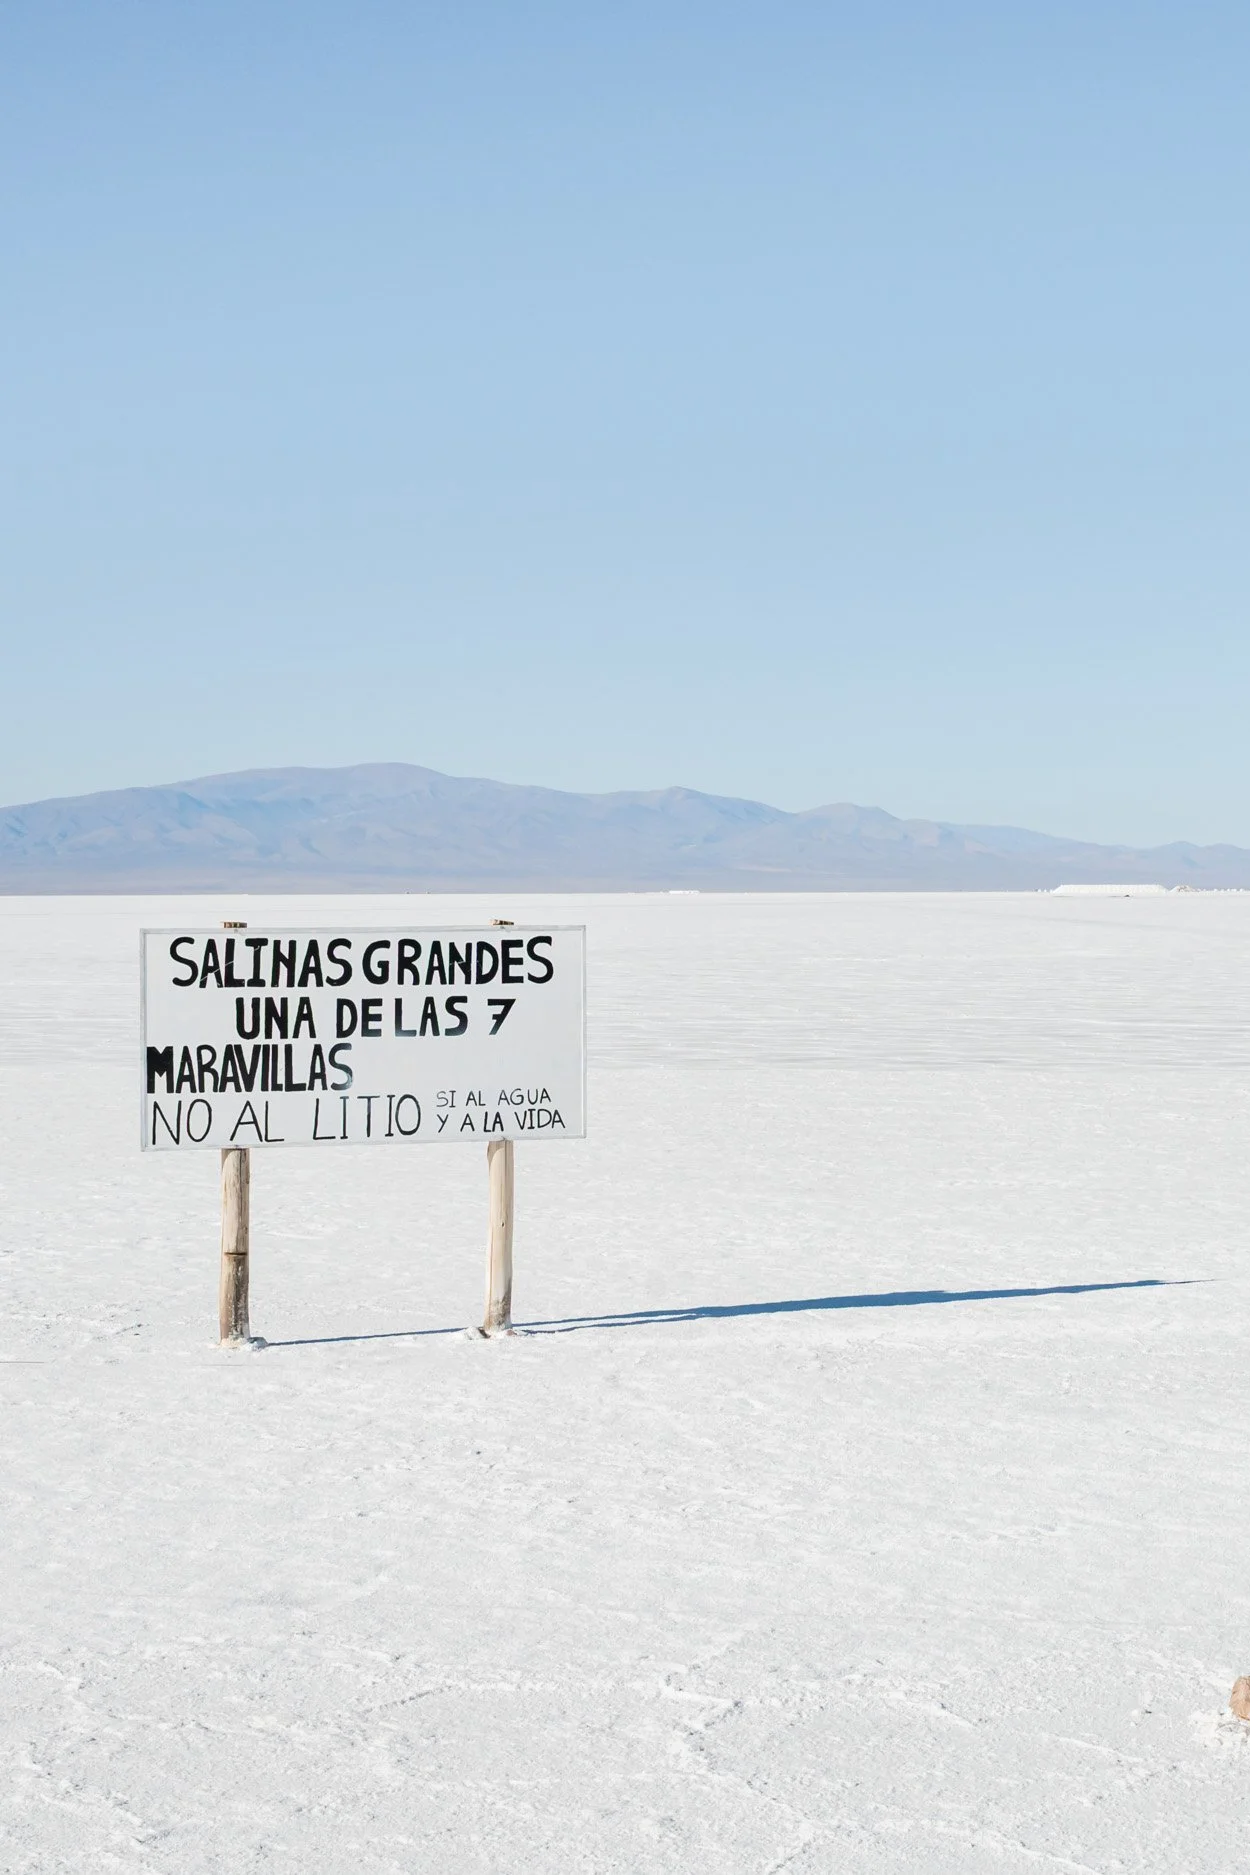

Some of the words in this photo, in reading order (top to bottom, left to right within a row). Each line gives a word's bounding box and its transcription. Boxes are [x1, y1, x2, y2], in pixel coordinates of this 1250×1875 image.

[169, 936, 353, 988] SALINAS
[362, 935, 555, 986] GRANDES
[235, 996, 317, 1040] UNA
[336, 997, 383, 1039] DE
[394, 996, 468, 1037] LAS
[487, 998, 517, 1036] 7
[146, 1042, 354, 1094] MARAVILLAS
[152, 1098, 213, 1146] NO
[229, 1100, 285, 1143] AL
[312, 1093, 422, 1141] LITIO
[436, 1090, 456, 1108] SI
[466, 1089, 486, 1107] AL
[498, 1088, 552, 1107] AGUA
[436, 1112, 449, 1134] Y
[460, 1112, 475, 1132] A
[483, 1111, 504, 1132] LA
[514, 1108, 566, 1130] VIDA
